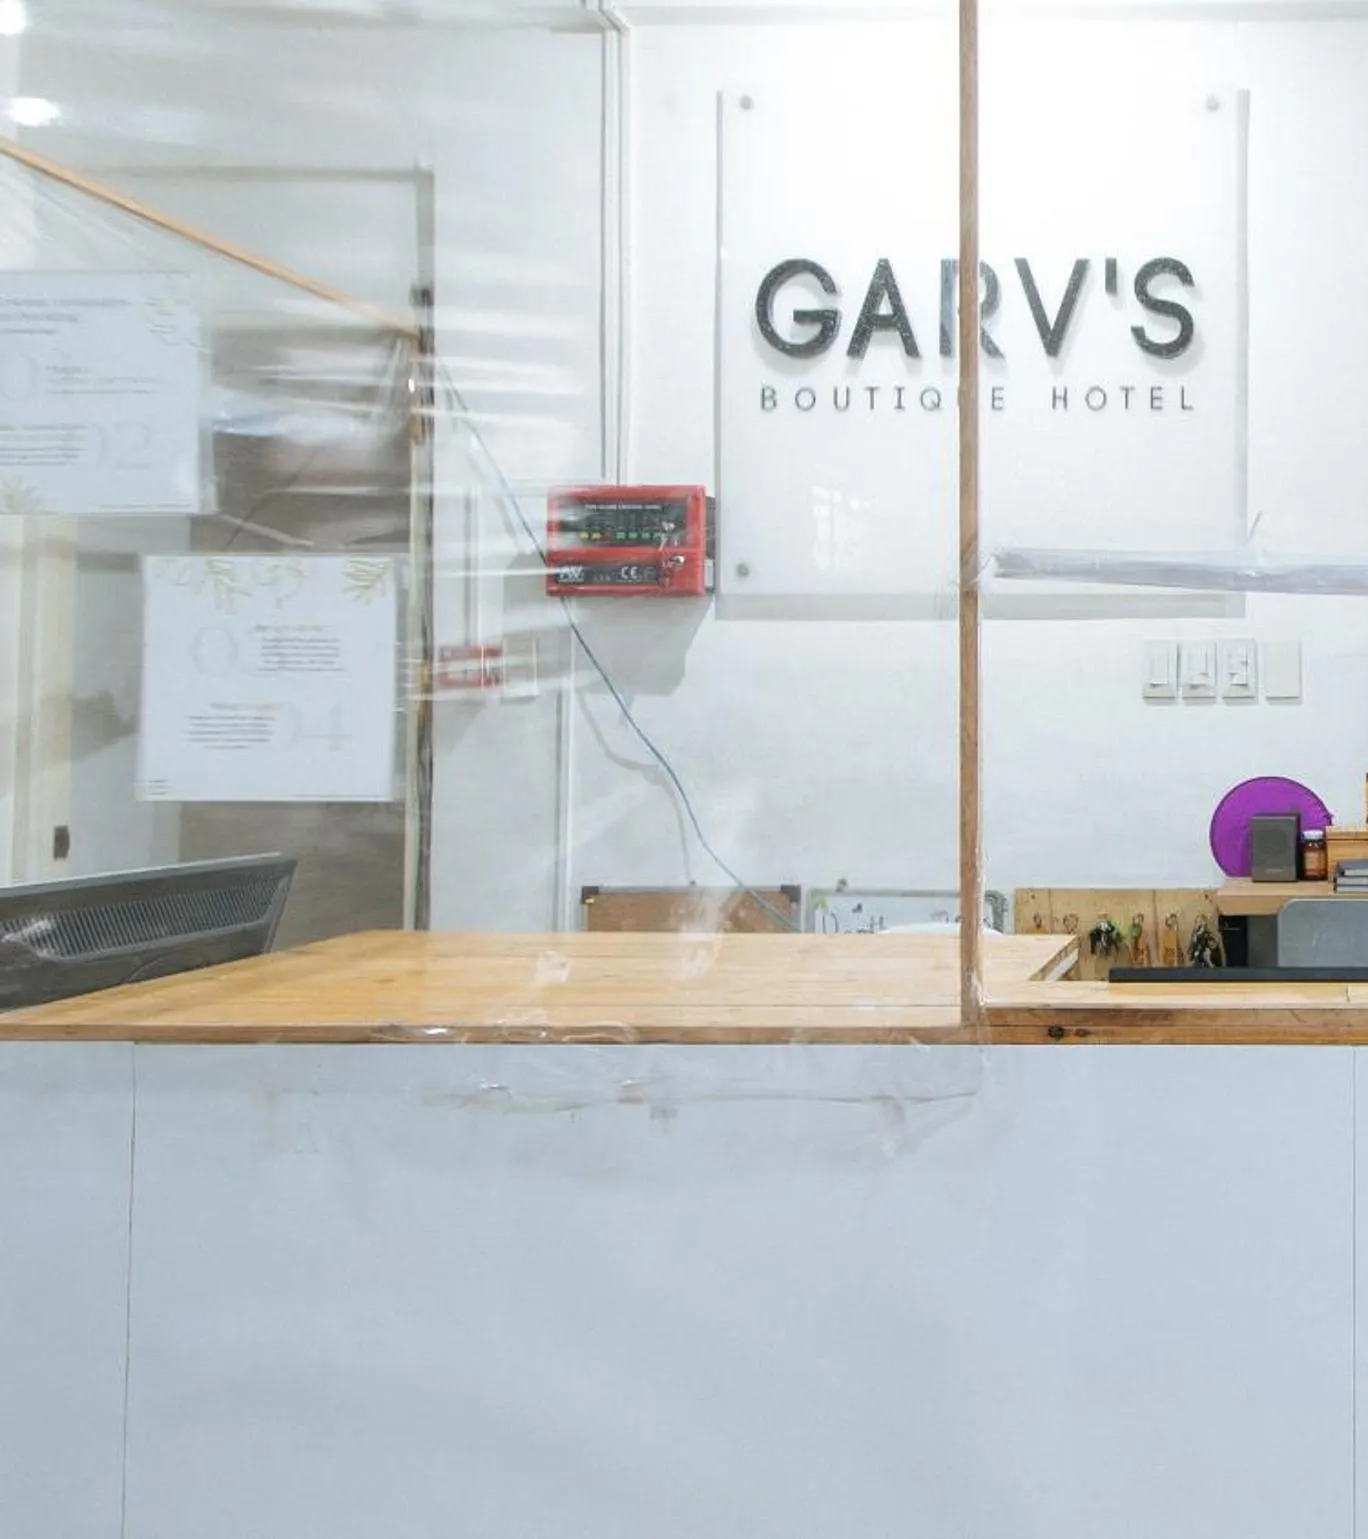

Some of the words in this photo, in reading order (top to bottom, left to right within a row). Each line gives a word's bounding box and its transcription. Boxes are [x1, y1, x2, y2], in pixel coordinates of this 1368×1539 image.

[755, 257, 1196, 360] GARV'S
[760, 385, 1006, 412] BOUTIQE
[1052, 386, 1194, 412] HOTEL
